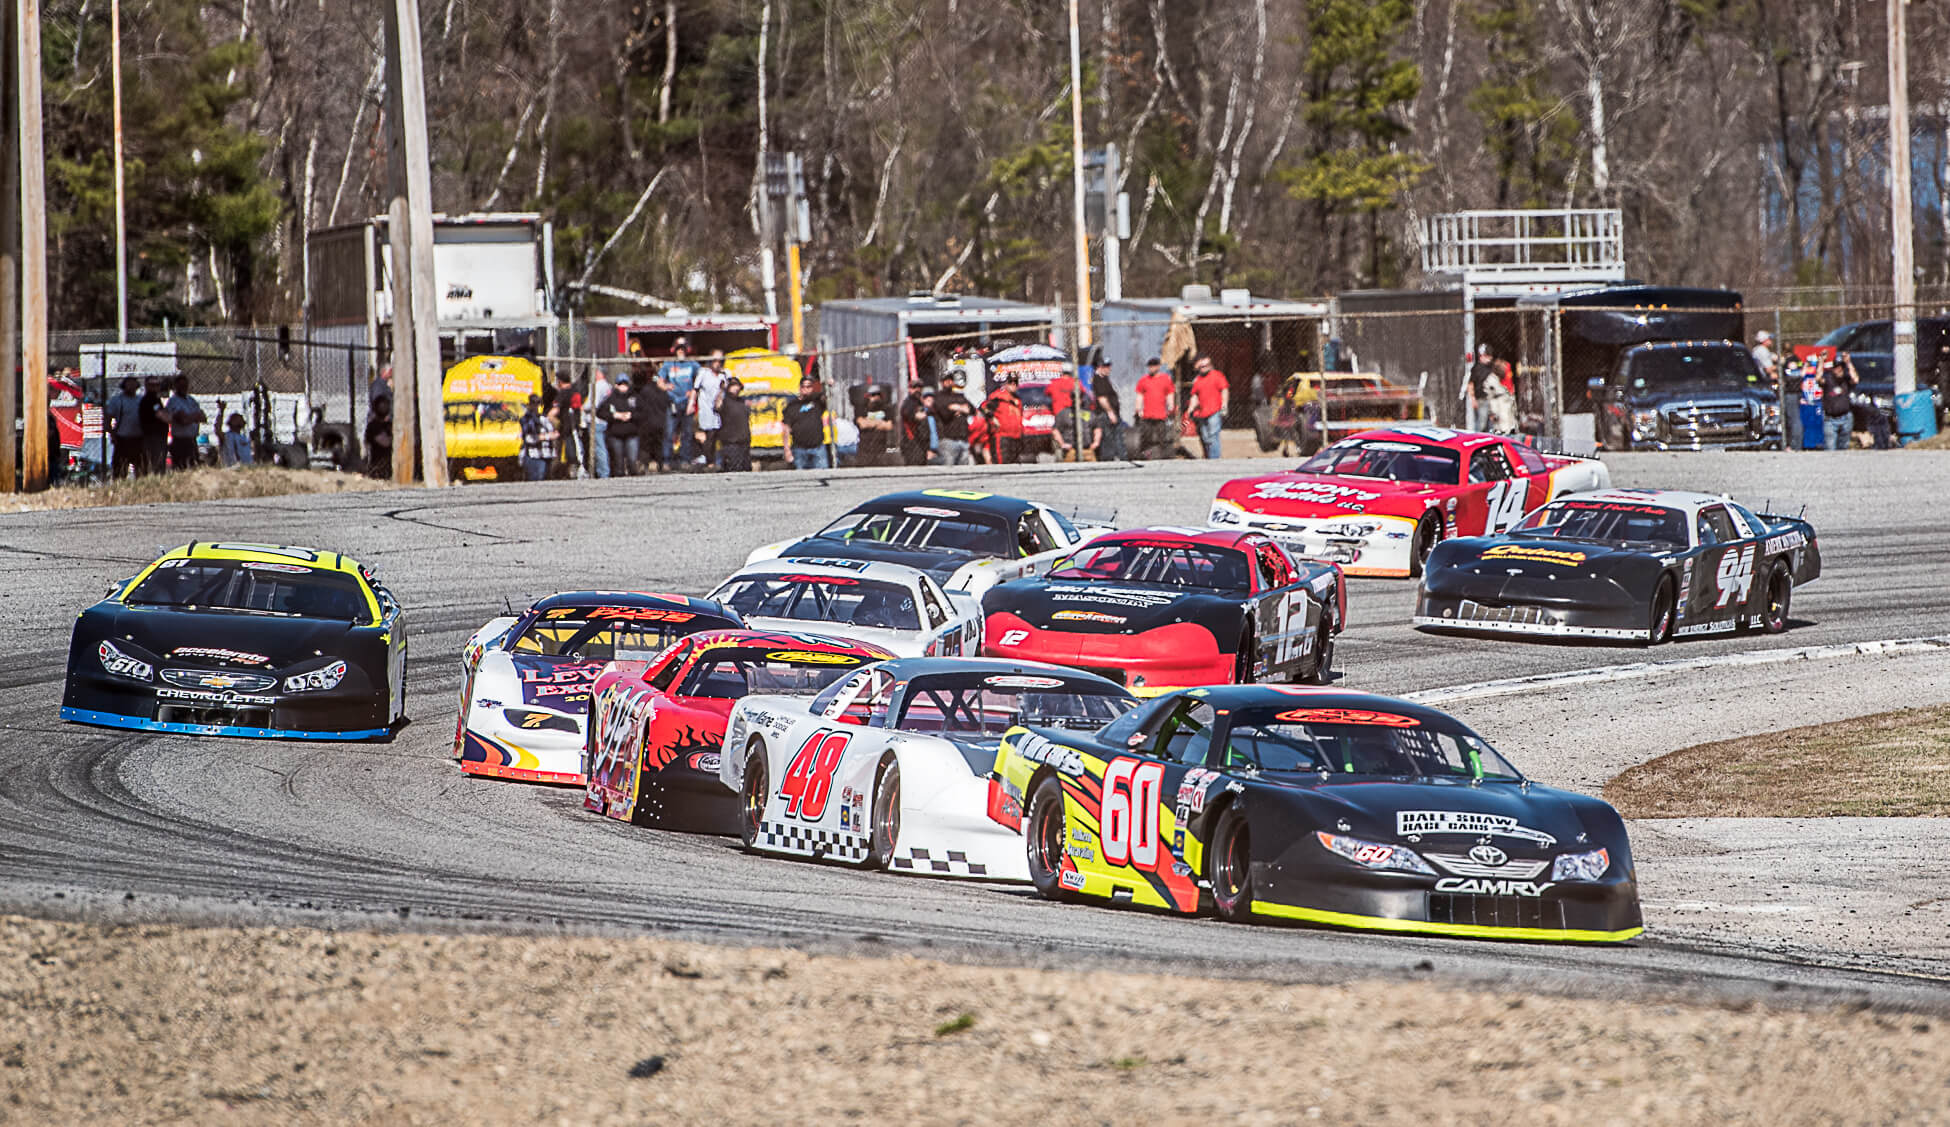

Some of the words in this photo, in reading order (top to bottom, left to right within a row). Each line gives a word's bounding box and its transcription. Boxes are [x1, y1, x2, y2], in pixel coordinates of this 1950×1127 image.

[1484, 477, 1531, 537] 14
[1714, 542, 1757, 610] 94
[1276, 589, 1315, 665] 12
[999, 630, 1029, 645] 12
[156, 689, 253, 703] CHEVROLET
[521, 713, 553, 728] 7
[778, 727, 854, 823] 48
[1099, 756, 1166, 873] 60
[1456, 814, 1512, 826] SHAW
[1449, 823, 1489, 831] CARS
[1354, 844, 1393, 863] 60
[1434, 877, 1556, 897] CAMRY
